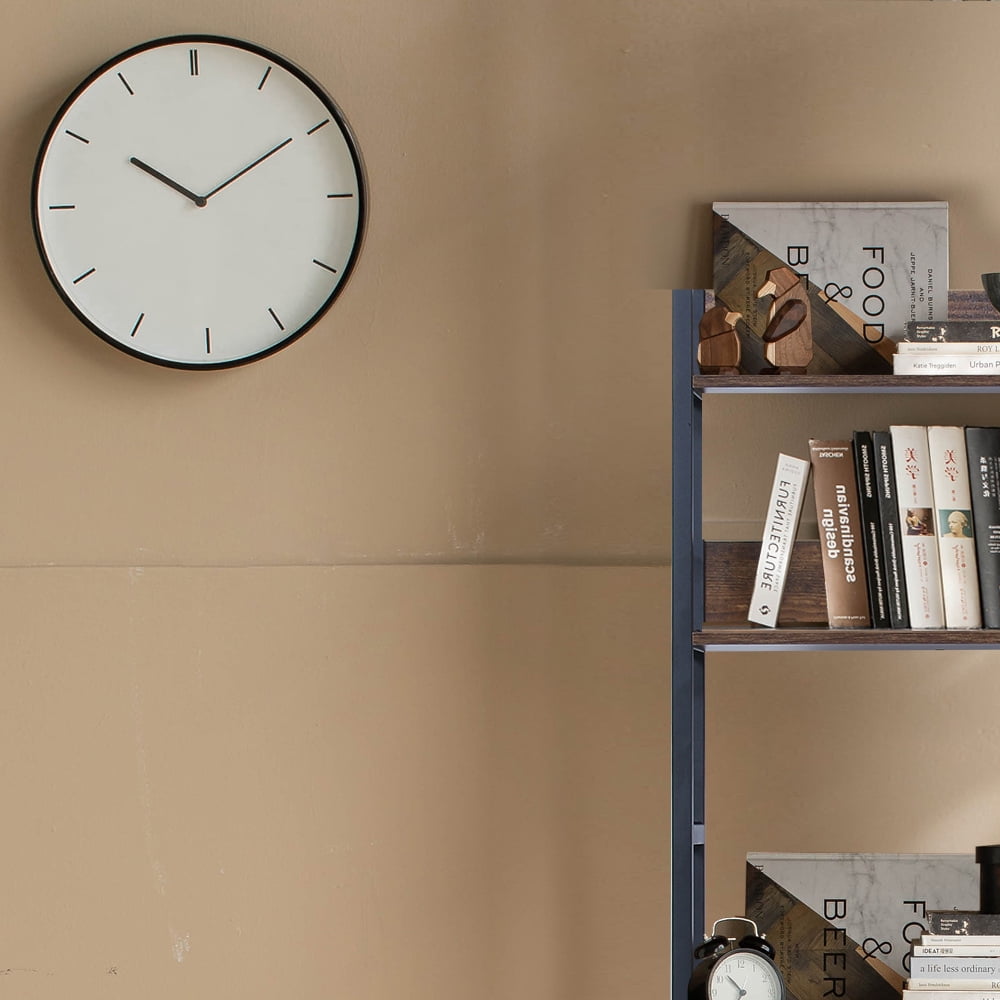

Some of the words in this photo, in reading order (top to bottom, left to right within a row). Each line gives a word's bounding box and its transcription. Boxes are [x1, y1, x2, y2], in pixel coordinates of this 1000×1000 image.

[824, 282, 853, 304] &
[862, 247, 885, 343] FOOD
[977, 345, 994, 353] ROY
[970, 360, 994, 368] Urban
[823, 899, 847, 997] BEER
[862, 938, 893, 960] &
[927, 964, 941, 973] life
[943, 964, 959, 973] less
[961, 964, 996, 975] ordinary
